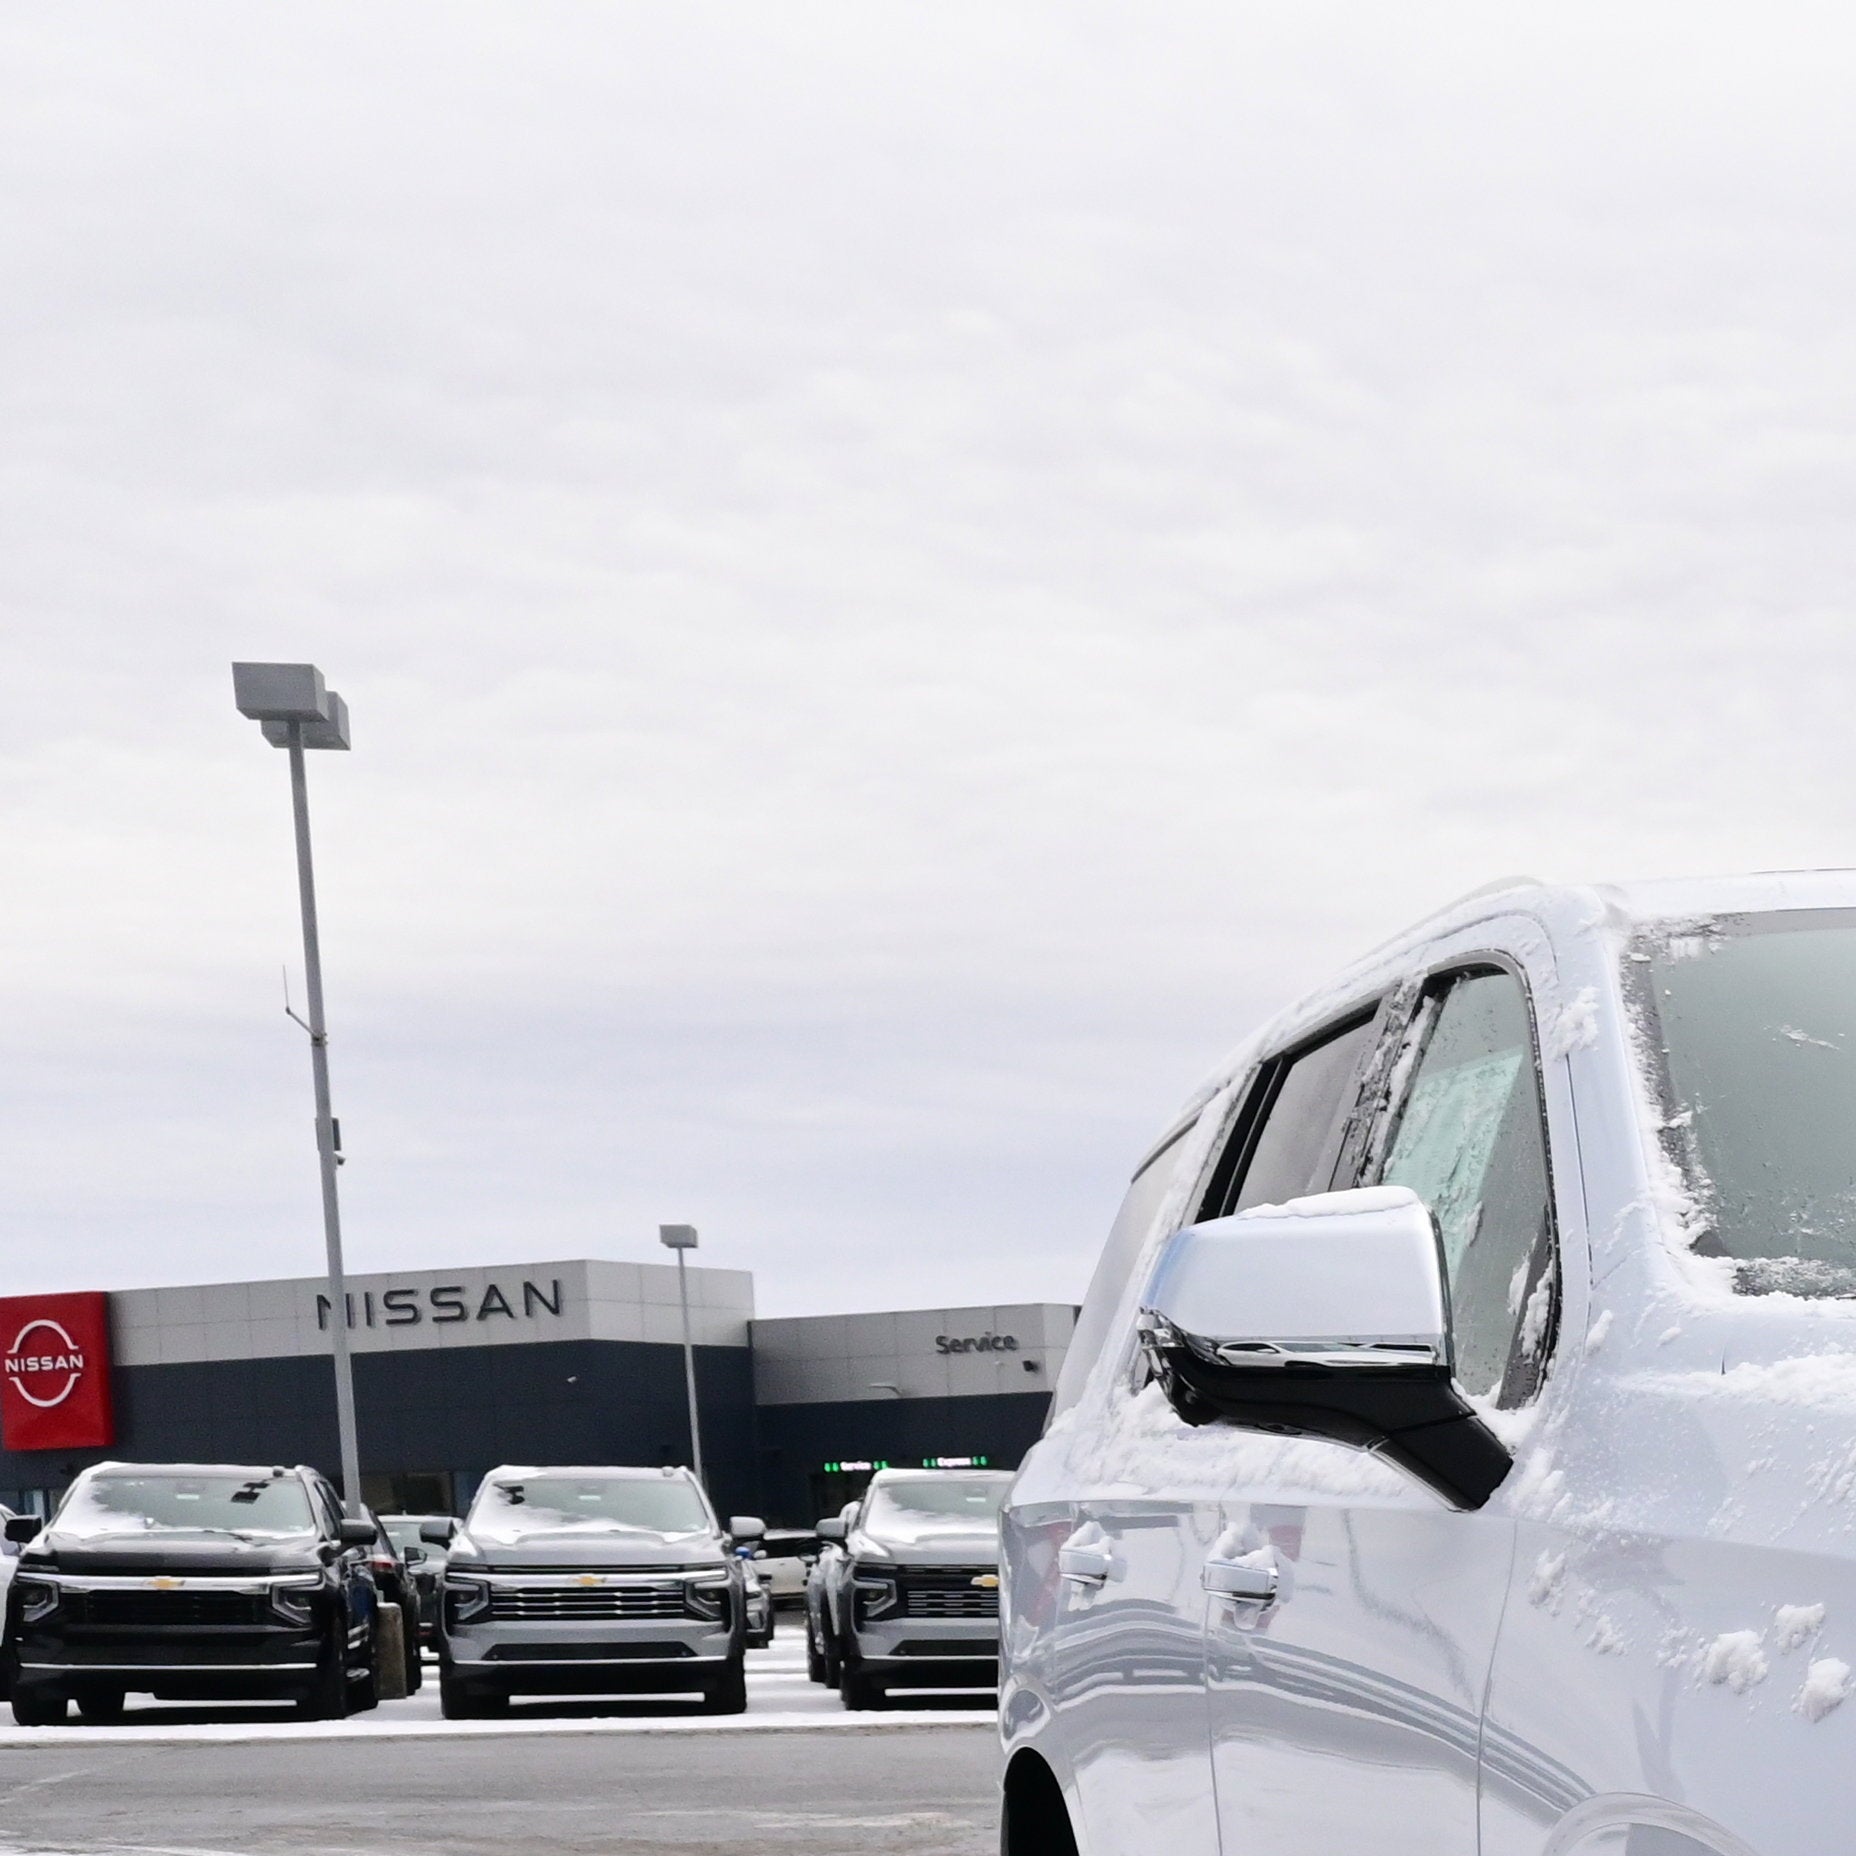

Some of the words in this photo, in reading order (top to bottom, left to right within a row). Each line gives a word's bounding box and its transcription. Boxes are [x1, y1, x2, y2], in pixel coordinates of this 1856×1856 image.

[316, 1279, 562, 1330] NISSAN
[935, 1331, 1019, 1354] Service
[4, 1354, 84, 1373] NISSAN
